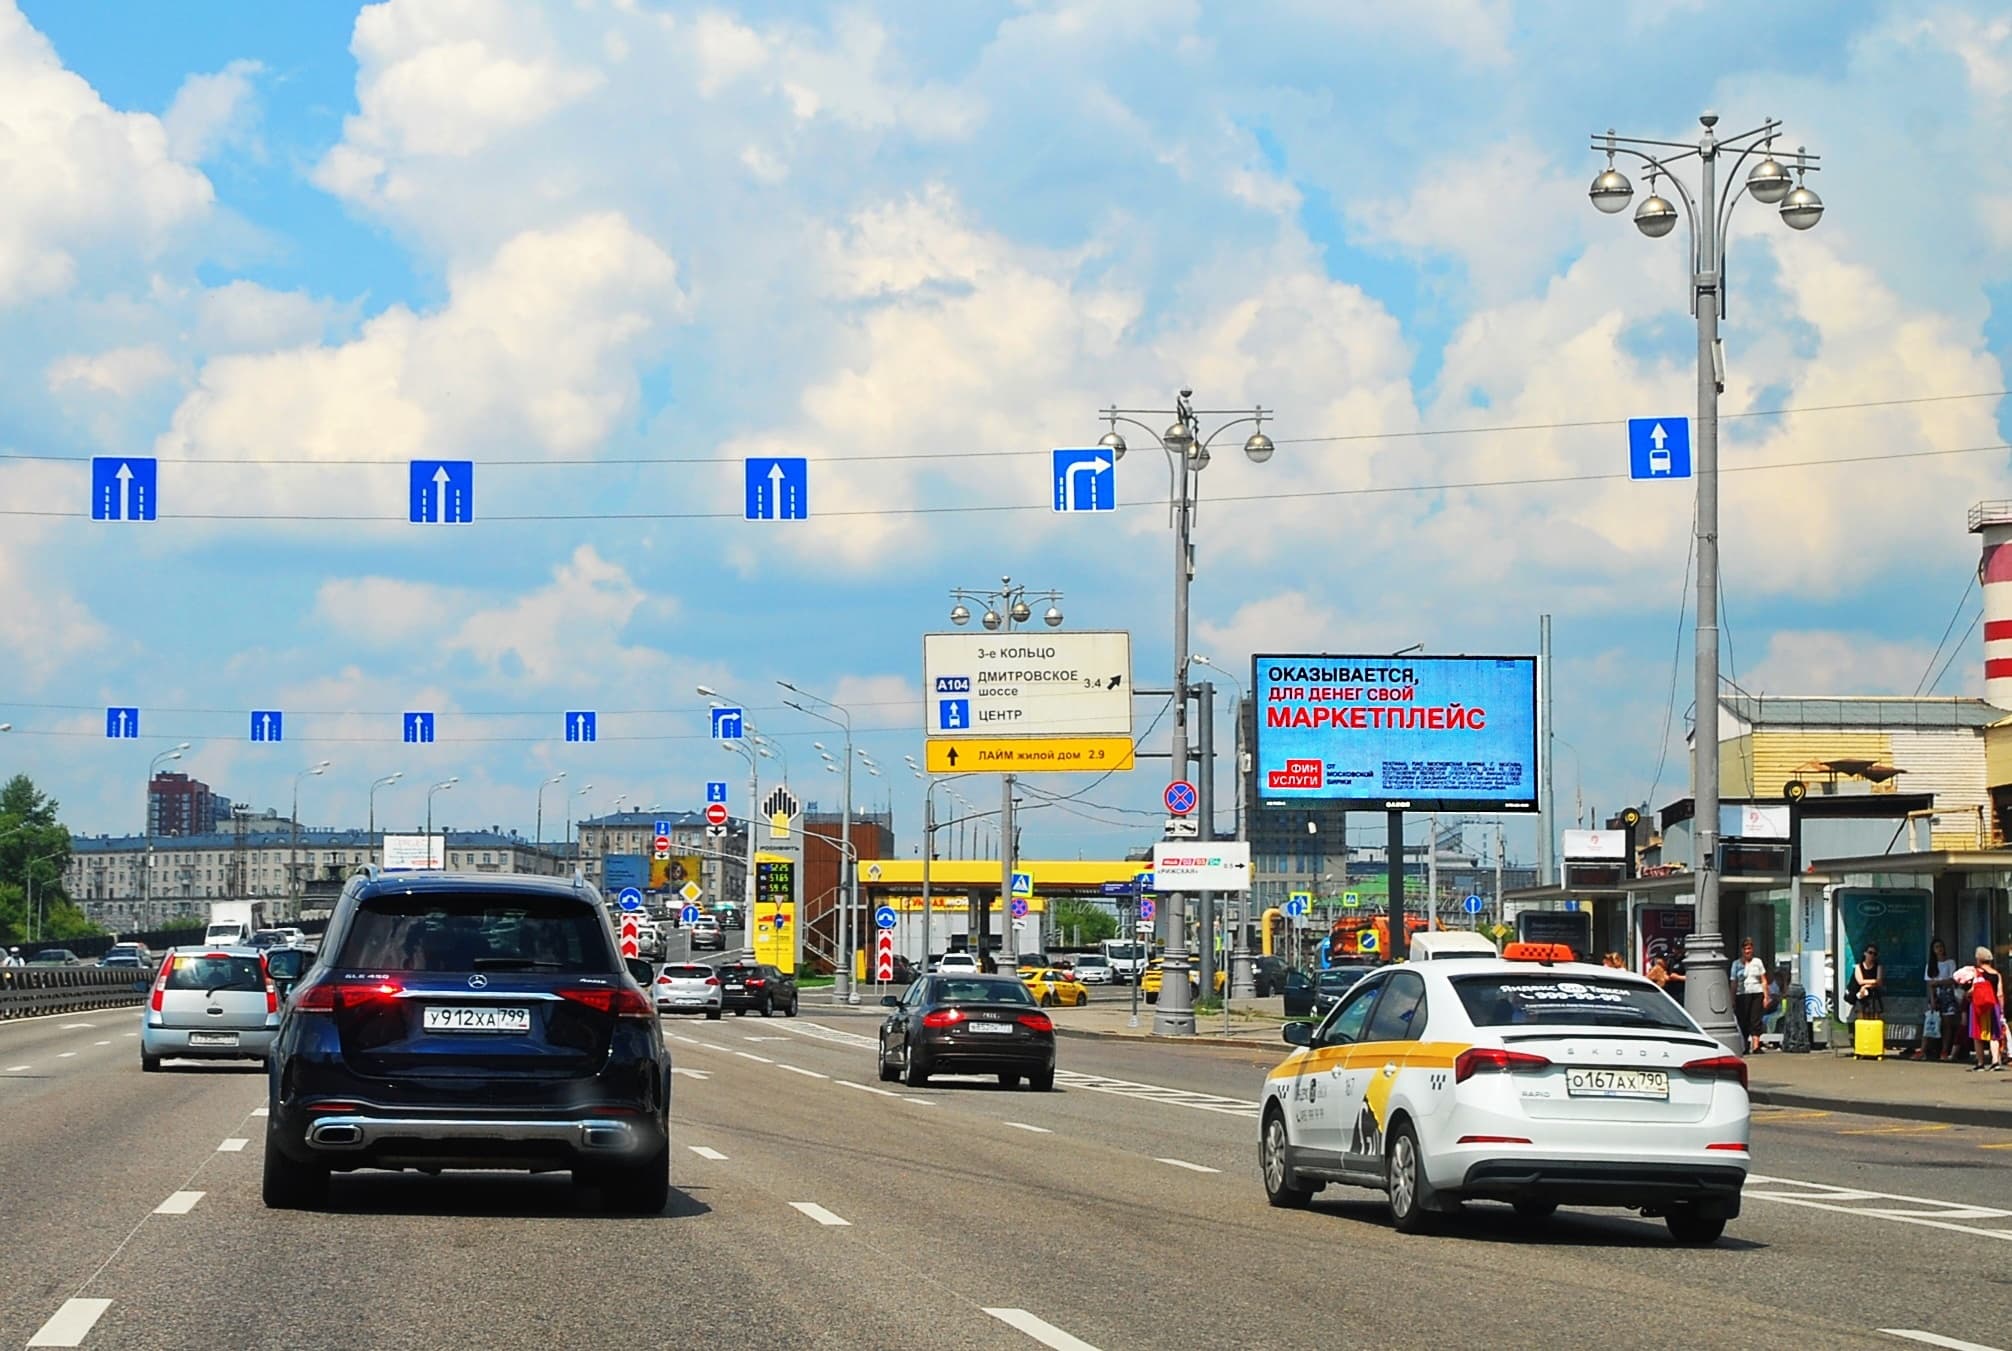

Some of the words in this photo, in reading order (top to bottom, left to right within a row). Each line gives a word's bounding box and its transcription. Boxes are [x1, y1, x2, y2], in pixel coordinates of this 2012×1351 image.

[978, 649, 996, 659] 3-е
[1000, 648, 1055, 660] КОЛЬЦО
[978, 670, 1078, 683] ДМИТРОВСКОЕ
[1268, 667, 1419, 685] ОКАЗЫВАЕТСЯ,
[937, 679, 968, 691] А104
[1084, 679, 1101, 688] 3.4
[978, 687, 1018, 697] шоссе
[1268, 687, 1304, 702] ДЛЯ
[1308, 687, 1363, 702] ДЕНЕГ
[1367, 686, 1413, 701] СВОЙ
[979, 710, 1023, 721] ЦЕНТР
[1267, 703, 1486, 729] МАРКЕТПЛЕЙС
[978, 749, 1013, 761] ЛАЙМ
[1017, 749, 1054, 760] жилой
[1058, 752, 1081, 761] дом
[1088, 750, 1105, 760] 2.9
[1291, 763, 1318, 773] ФИН
[1272, 776, 1318, 785] УСЛУГИ
